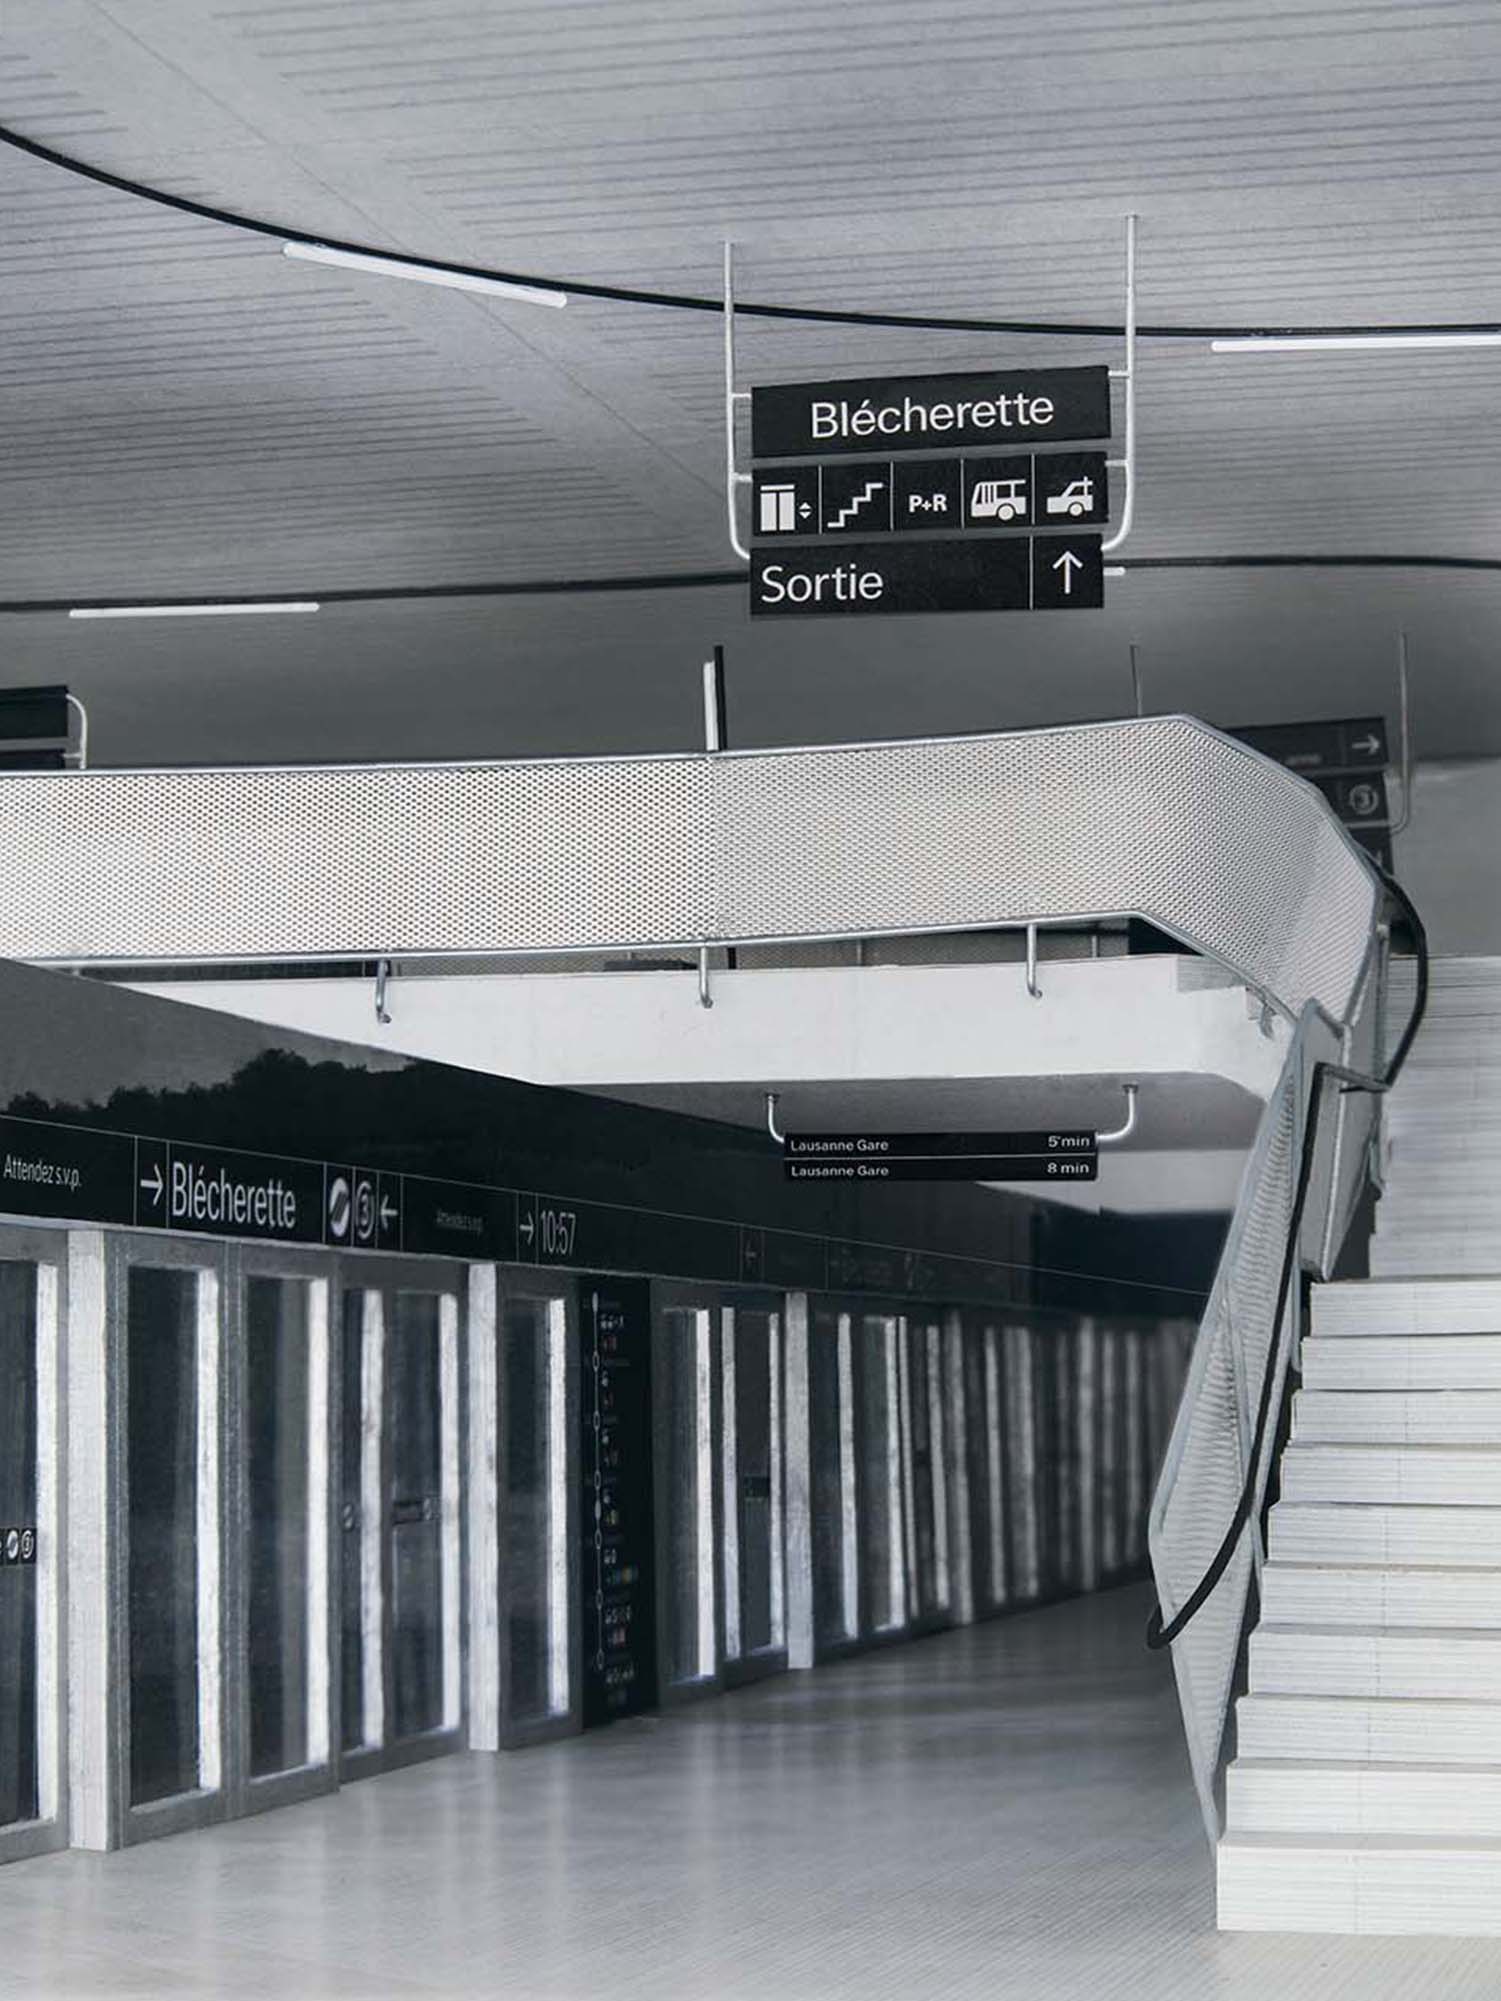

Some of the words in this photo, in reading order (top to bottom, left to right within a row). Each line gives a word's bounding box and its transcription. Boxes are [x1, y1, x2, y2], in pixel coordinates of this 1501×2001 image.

[811, 392, 1054, 439] Blécherette
[909, 494, 948, 513] P+R
[761, 564, 884, 603] Sortie
[790, 1139, 854, 1152] Lausanne
[857, 1138, 889, 1151] Gare
[1061, 1135, 1090, 1147] min
[3, 1154, 54, 1184] Attendez
[791, 1165, 854, 1177] Lausanne
[857, 1164, 889, 1177] Gare
[1047, 1162, 1057, 1174] 8
[1060, 1162, 1089, 1174] min
[172, 1161, 296, 1229] Blécherette
